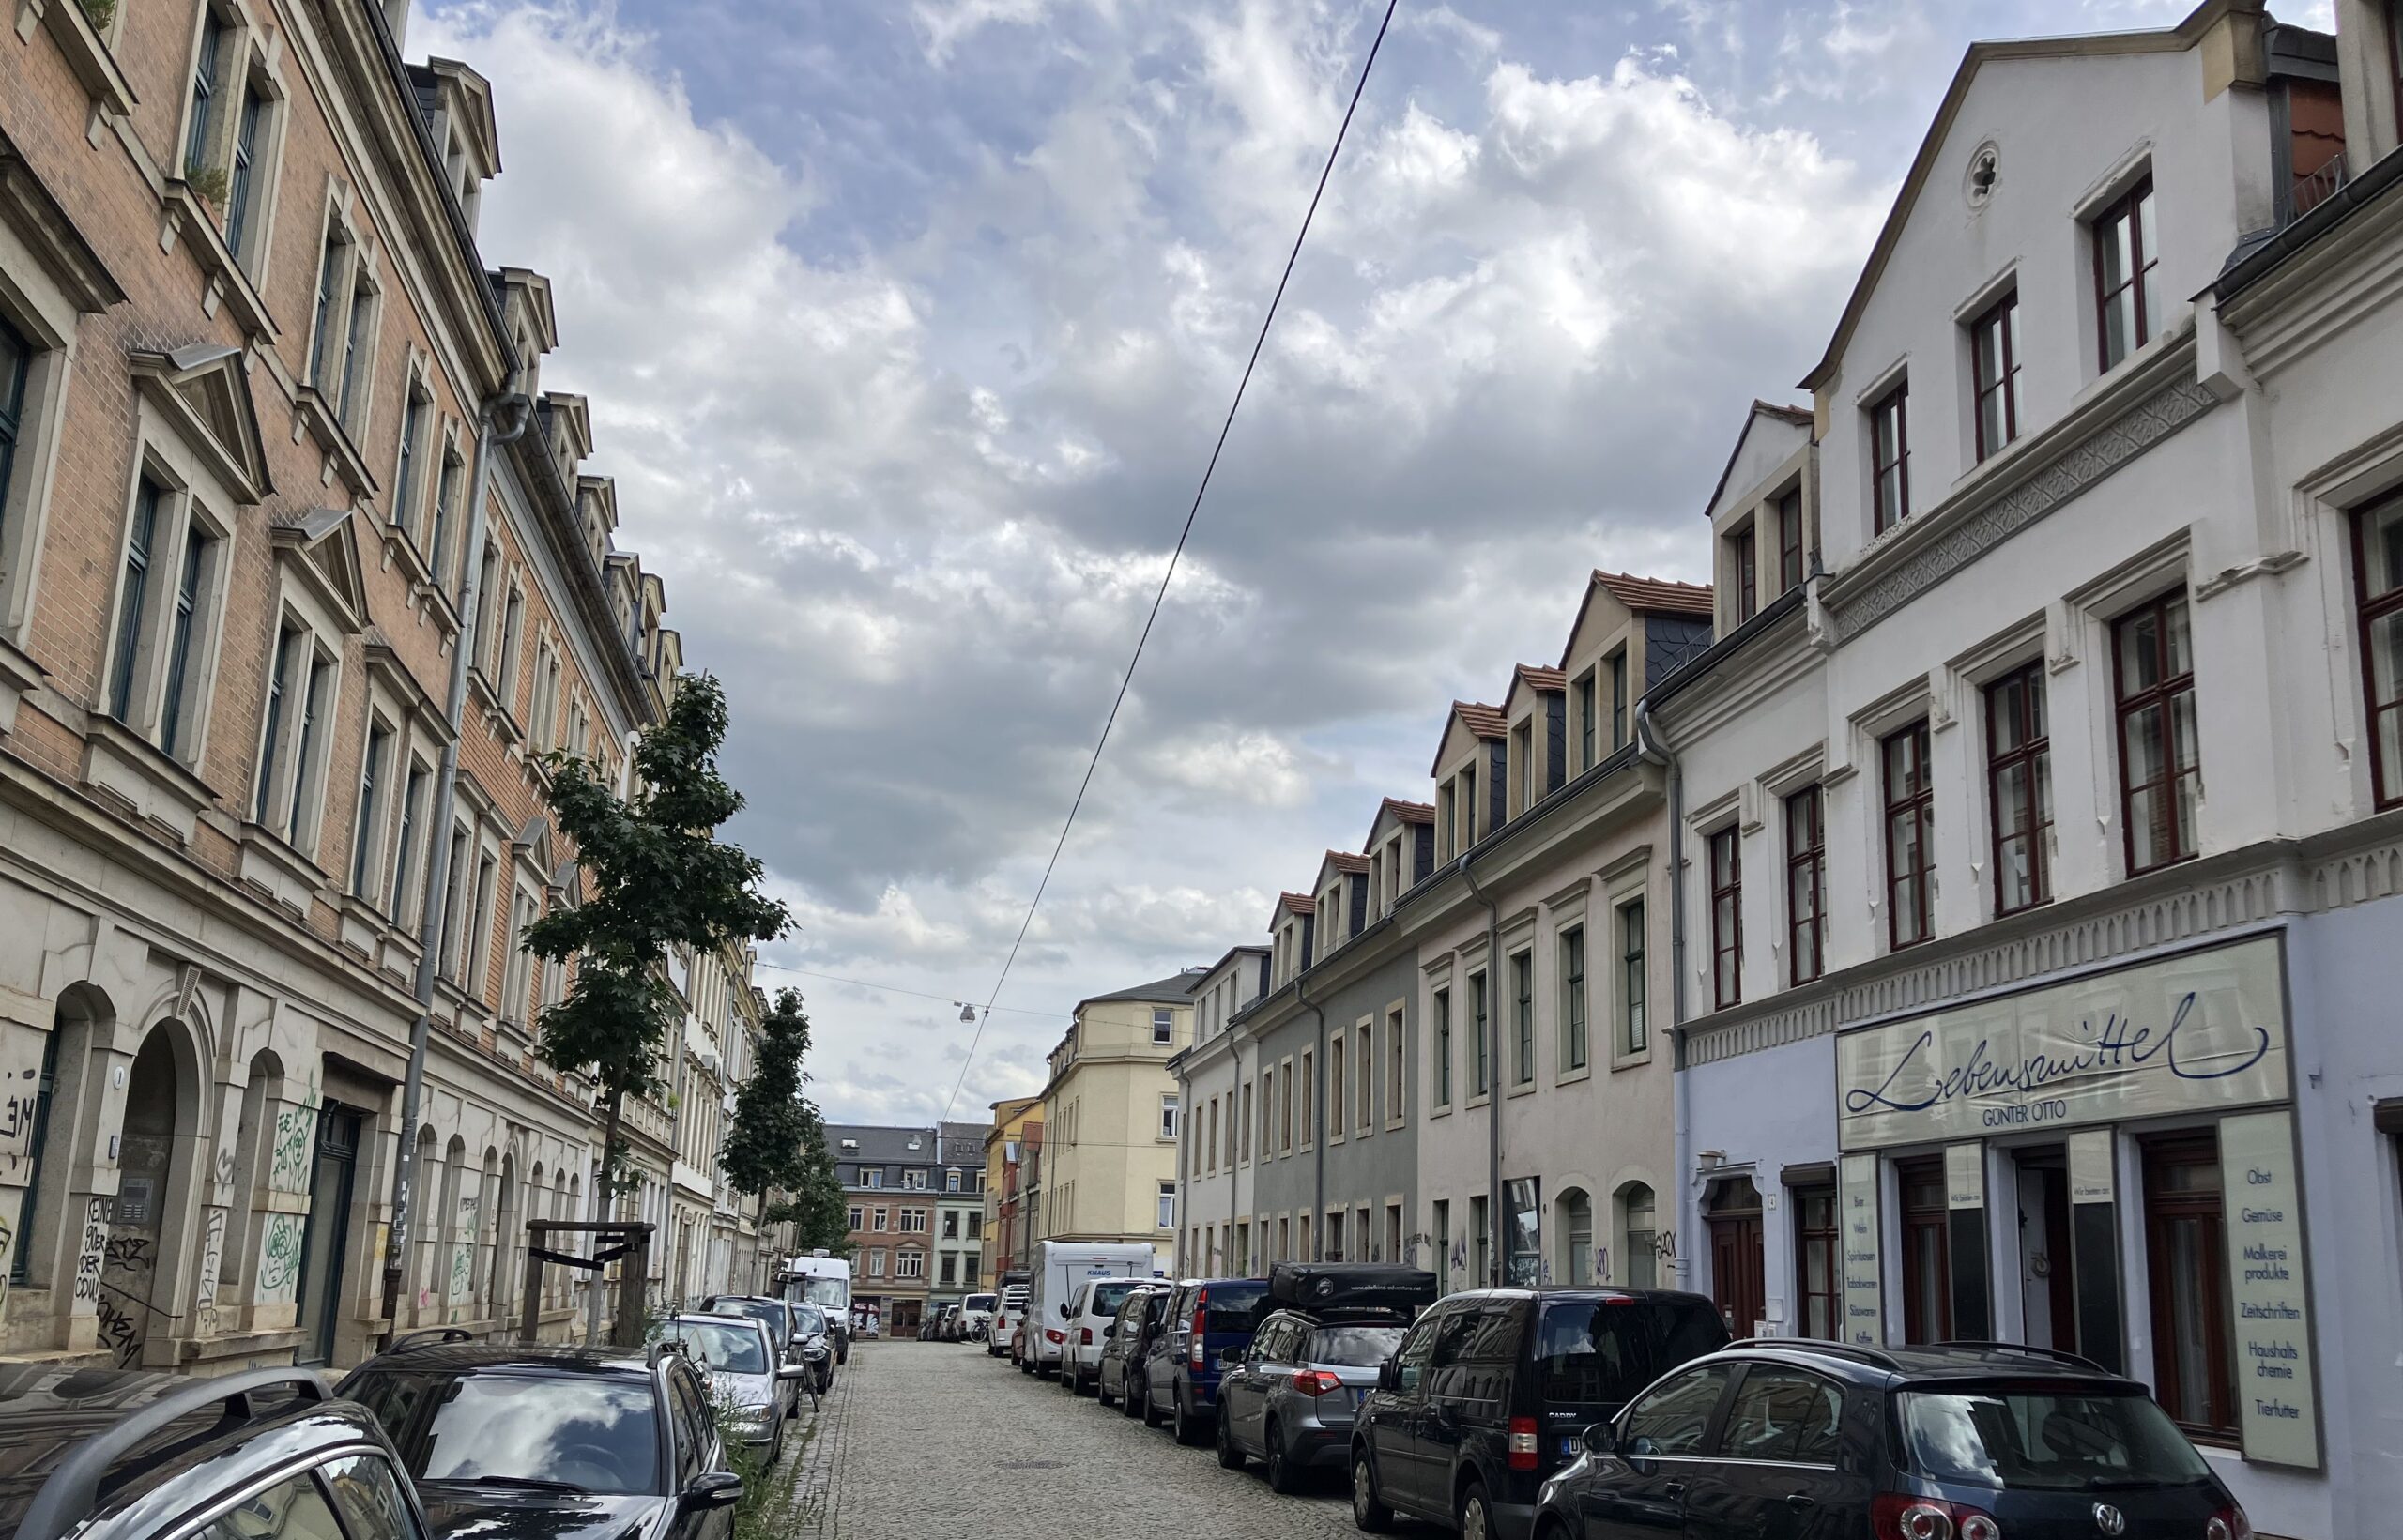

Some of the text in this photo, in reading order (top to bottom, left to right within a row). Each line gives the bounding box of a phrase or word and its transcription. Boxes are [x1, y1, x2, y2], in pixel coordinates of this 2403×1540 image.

[1845, 991, 2270, 1112] Lebensmittel
[2031, 1099, 2066, 1121] OTTO
[2247, 1167, 2272, 1184] Obst
[86, 1197, 113, 1224] KEINE
[1854, 1196, 1864, 1207] Bier
[2242, 1207, 2283, 1222] Gemüse
[1853, 1222, 1867, 1234] Wein
[1847, 1250, 1875, 1265] Spirituosen
[2243, 1243, 2288, 1261] Molkerei
[79, 1254, 101, 1274] DER
[2244, 1262, 2289, 1285] produkte
[75, 1276, 99, 1303] CDU!
[2240, 1301, 2300, 1319] Zeitschriften
[2248, 1340, 2298, 1360] Haushalts
[2257, 1359, 2293, 1380] chemie
[2255, 1398, 2300, 1419] Tierfutter
